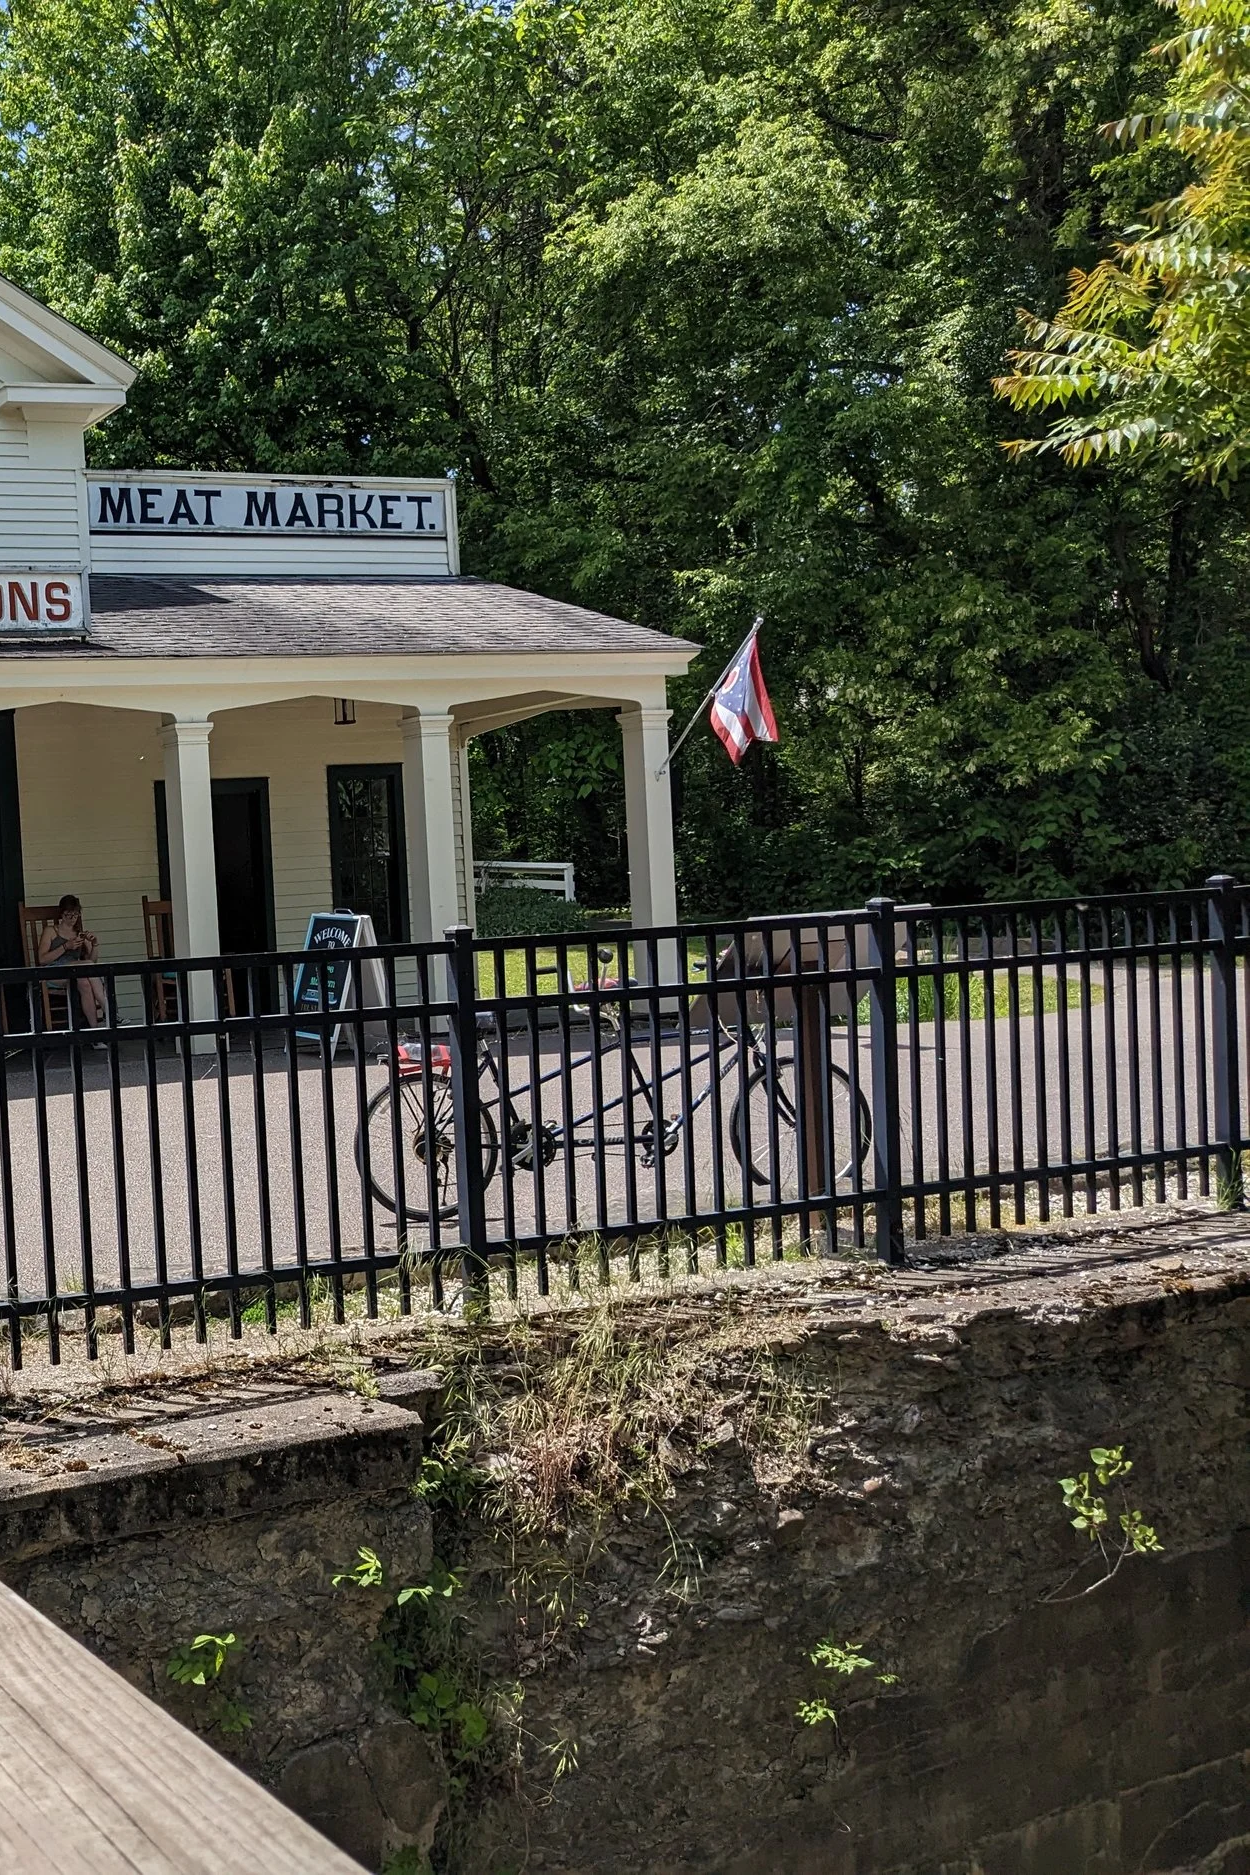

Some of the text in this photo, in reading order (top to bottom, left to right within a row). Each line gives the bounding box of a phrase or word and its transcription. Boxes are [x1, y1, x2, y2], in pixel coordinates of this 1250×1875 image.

[98, 487, 436, 530] MEAT MARKET.
[314, 927, 352, 948] WELCOME
